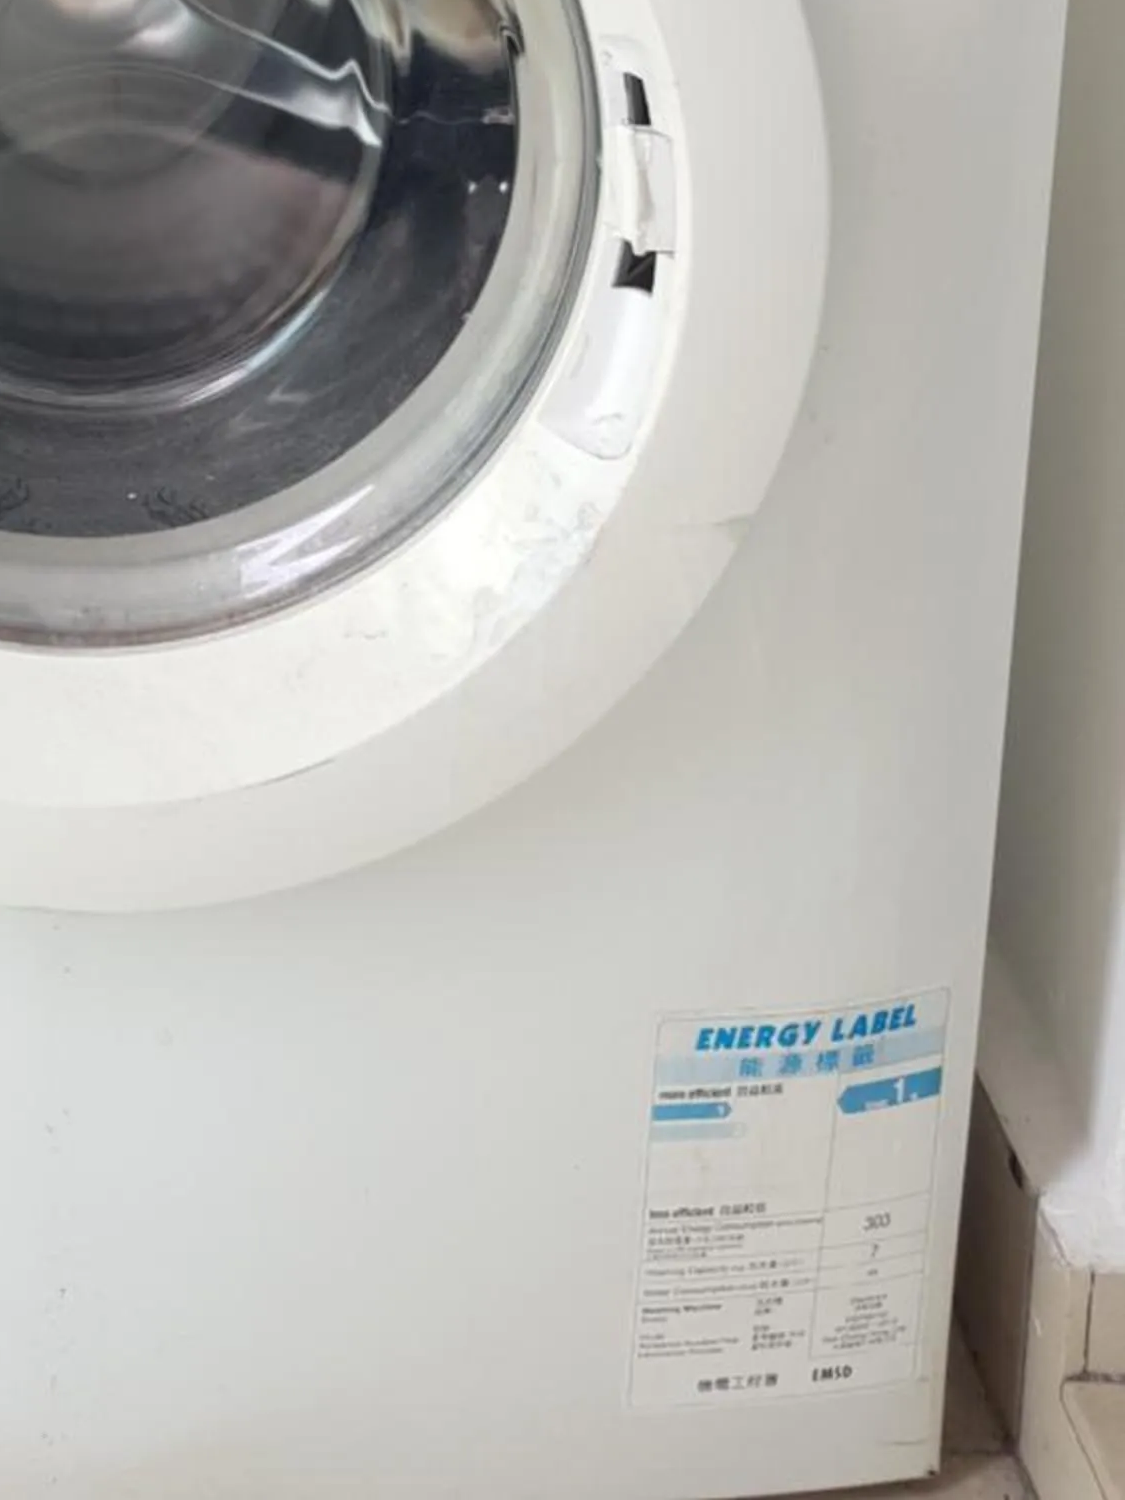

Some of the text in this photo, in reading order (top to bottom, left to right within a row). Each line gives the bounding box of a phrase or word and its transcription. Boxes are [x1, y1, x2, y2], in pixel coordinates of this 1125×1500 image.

[694, 1004, 917, 1052] ENERGY LABEL
[812, 1363, 854, 1383] EMSD
